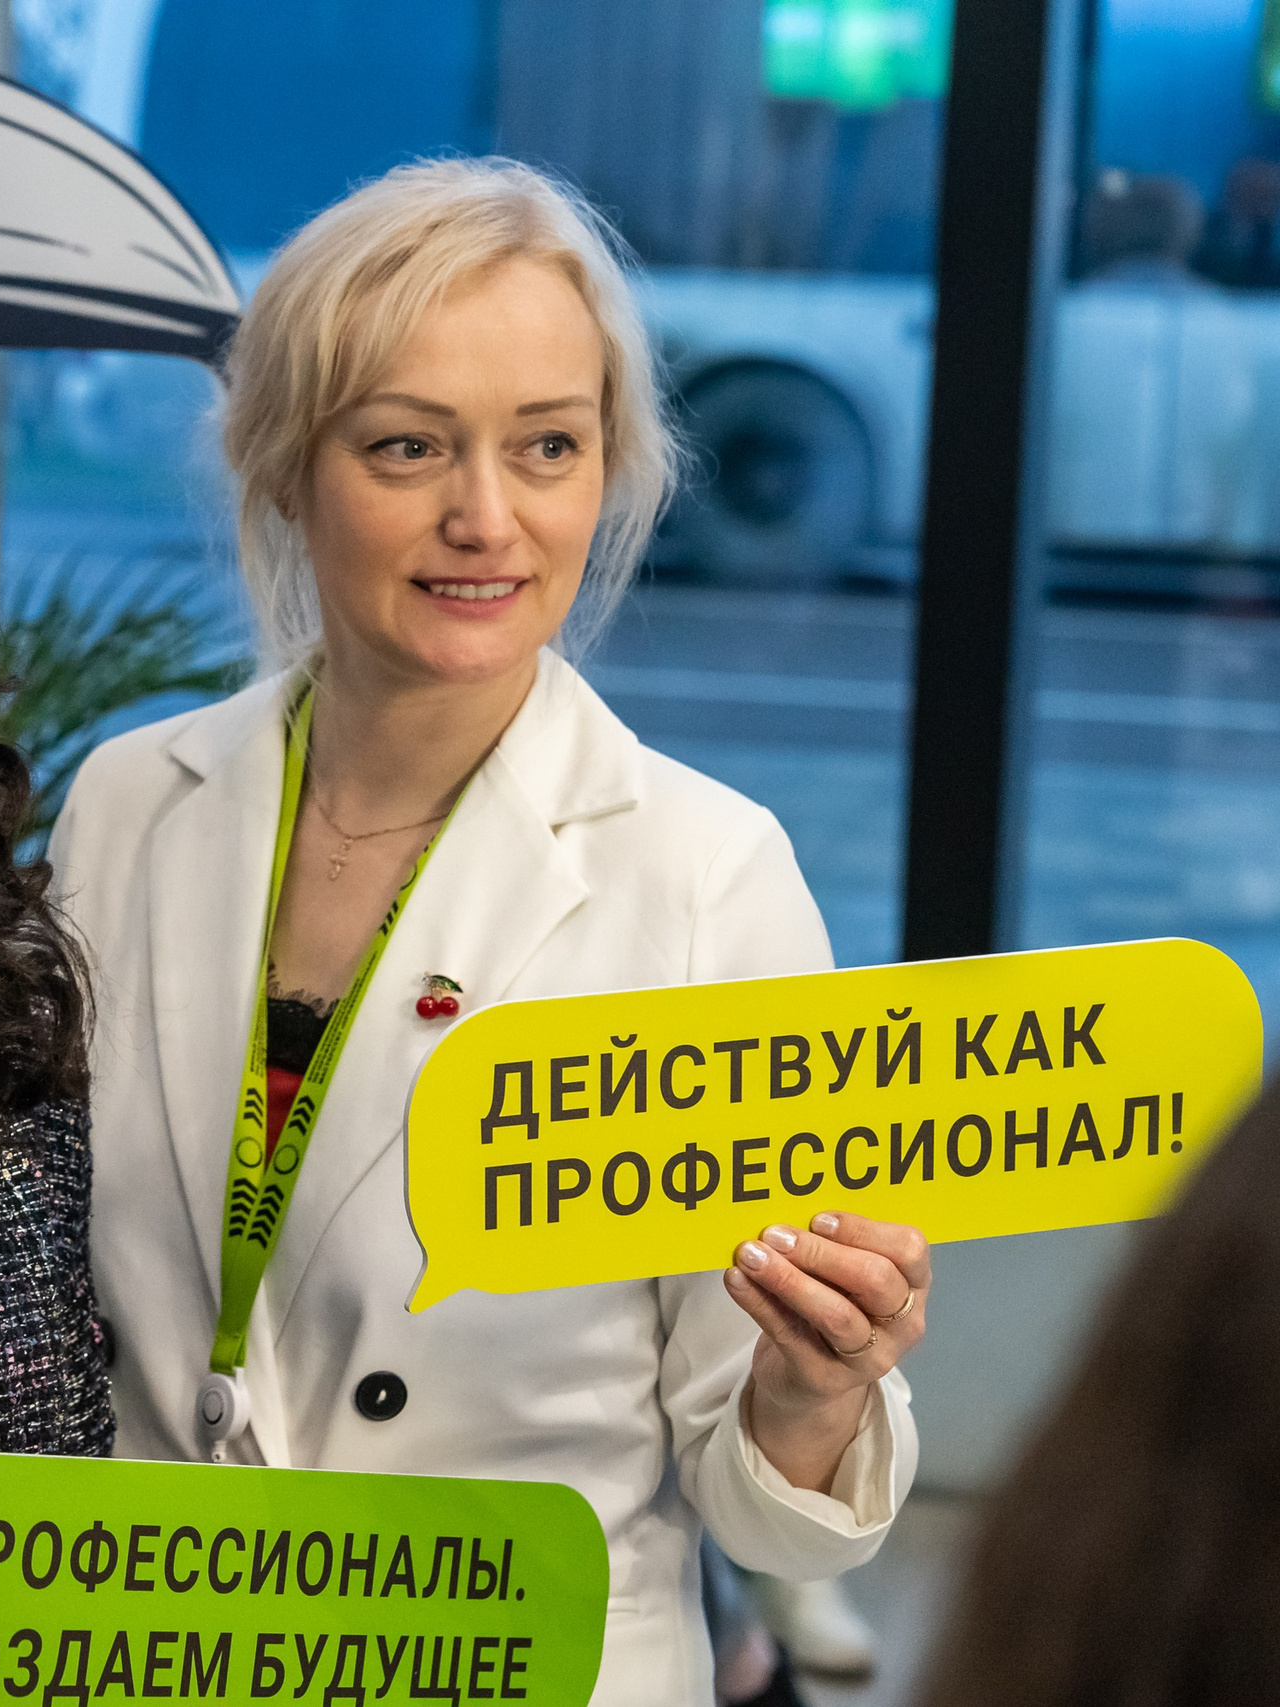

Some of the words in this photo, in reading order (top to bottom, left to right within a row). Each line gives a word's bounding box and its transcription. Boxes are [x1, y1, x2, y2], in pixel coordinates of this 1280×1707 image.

[480, 1006, 921, 1144] ДЕЙСТВУЙ
[954, 1003, 1107, 1080] КАК
[483, 1092, 1185, 1231] ПРОФЕССИОНАЛ!
[249, 1632, 534, 1707] БУДУЩЕЕ
